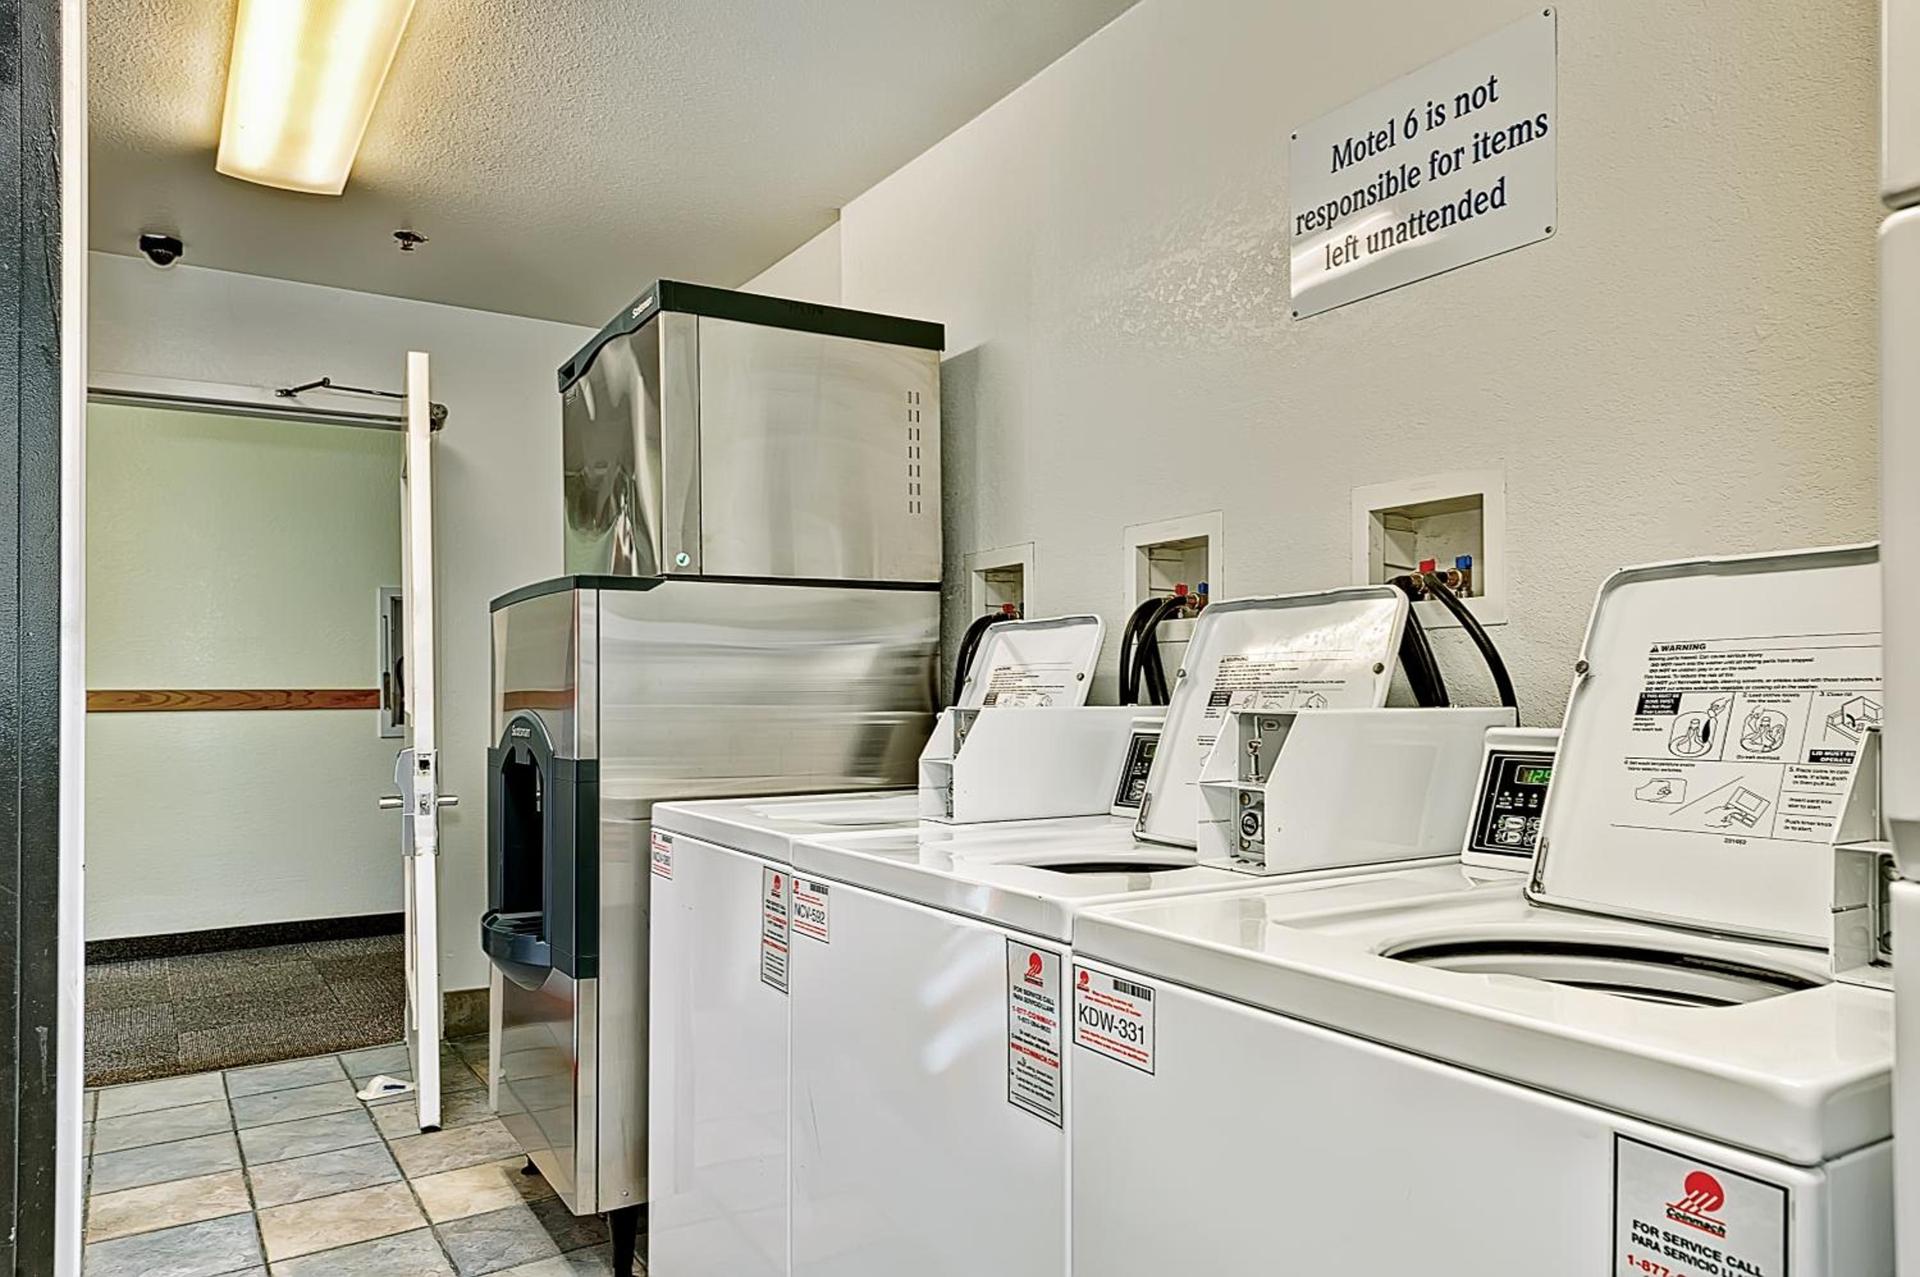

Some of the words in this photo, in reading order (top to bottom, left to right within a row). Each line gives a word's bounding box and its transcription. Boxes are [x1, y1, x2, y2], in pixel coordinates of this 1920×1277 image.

[1330, 119, 1396, 173] Motel
[1403, 108, 1418, 140] 6
[1425, 101, 1446, 131] is
[1454, 75, 1499, 119] not
[1296, 164, 1421, 236] responsible
[1428, 146, 1464, 181] for
[1472, 113, 1549, 164] items
[1324, 234, 1359, 270] left
[1366, 176, 1507, 254] unattended
[1661, 643, 1706, 652] WARNING
[794, 903, 826, 925] NCV-592
[1079, 1002, 1144, 1045] KDW-331
[1666, 1207, 1727, 1235] Coinmach
[1631, 1232, 1662, 1253] PARA
[1664, 1245, 1719, 1275] SERVICIO
[1632, 1220, 1660, 1238] FOR
[1662, 1231, 1722, 1262] SERVICE
[1726, 1255, 1765, 1277] CALL
